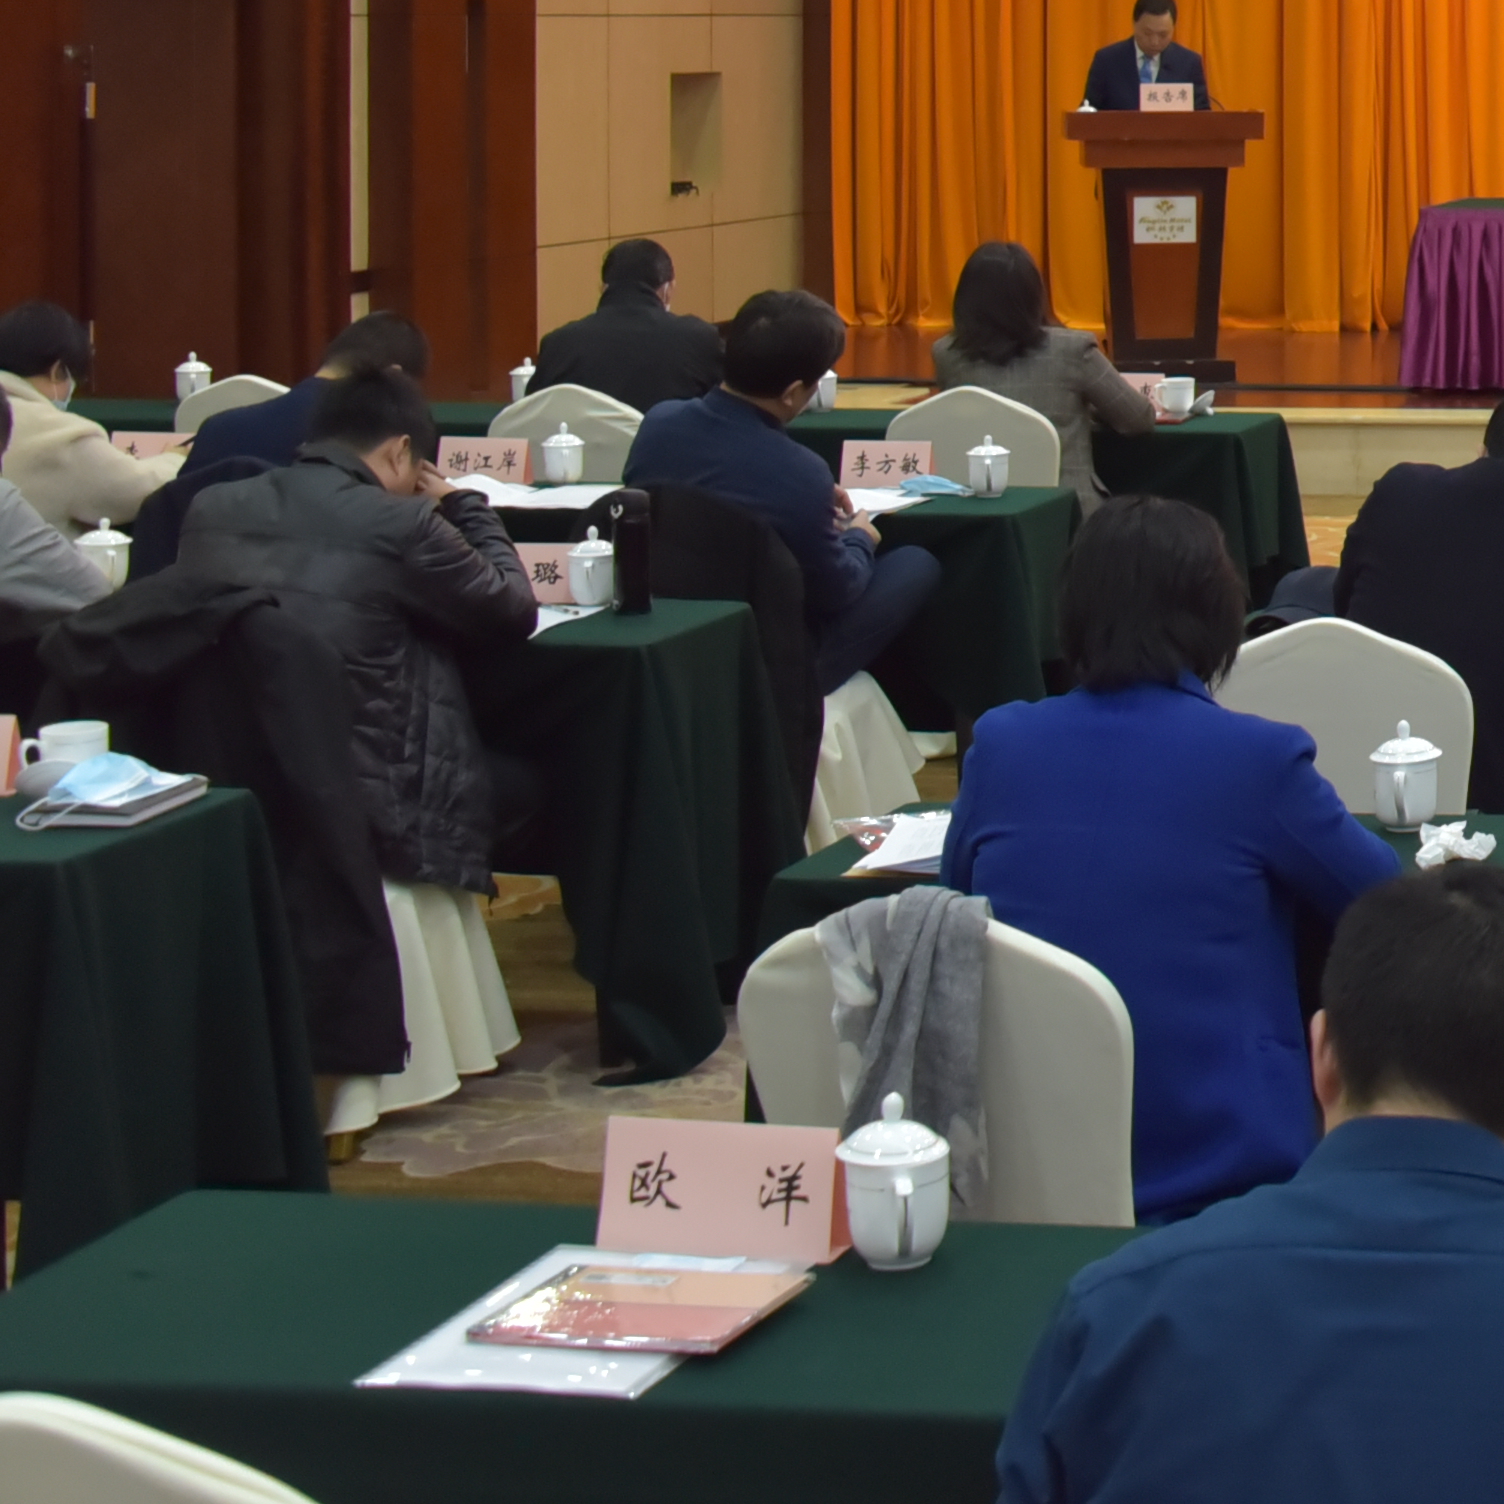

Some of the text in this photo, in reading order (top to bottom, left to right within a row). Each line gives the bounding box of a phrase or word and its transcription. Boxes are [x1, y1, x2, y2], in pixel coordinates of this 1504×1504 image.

[447, 448, 517, 475] 谢江岸
[851, 449, 924, 478] 李方敏
[629, 1151, 810, 1226] 欧洋
